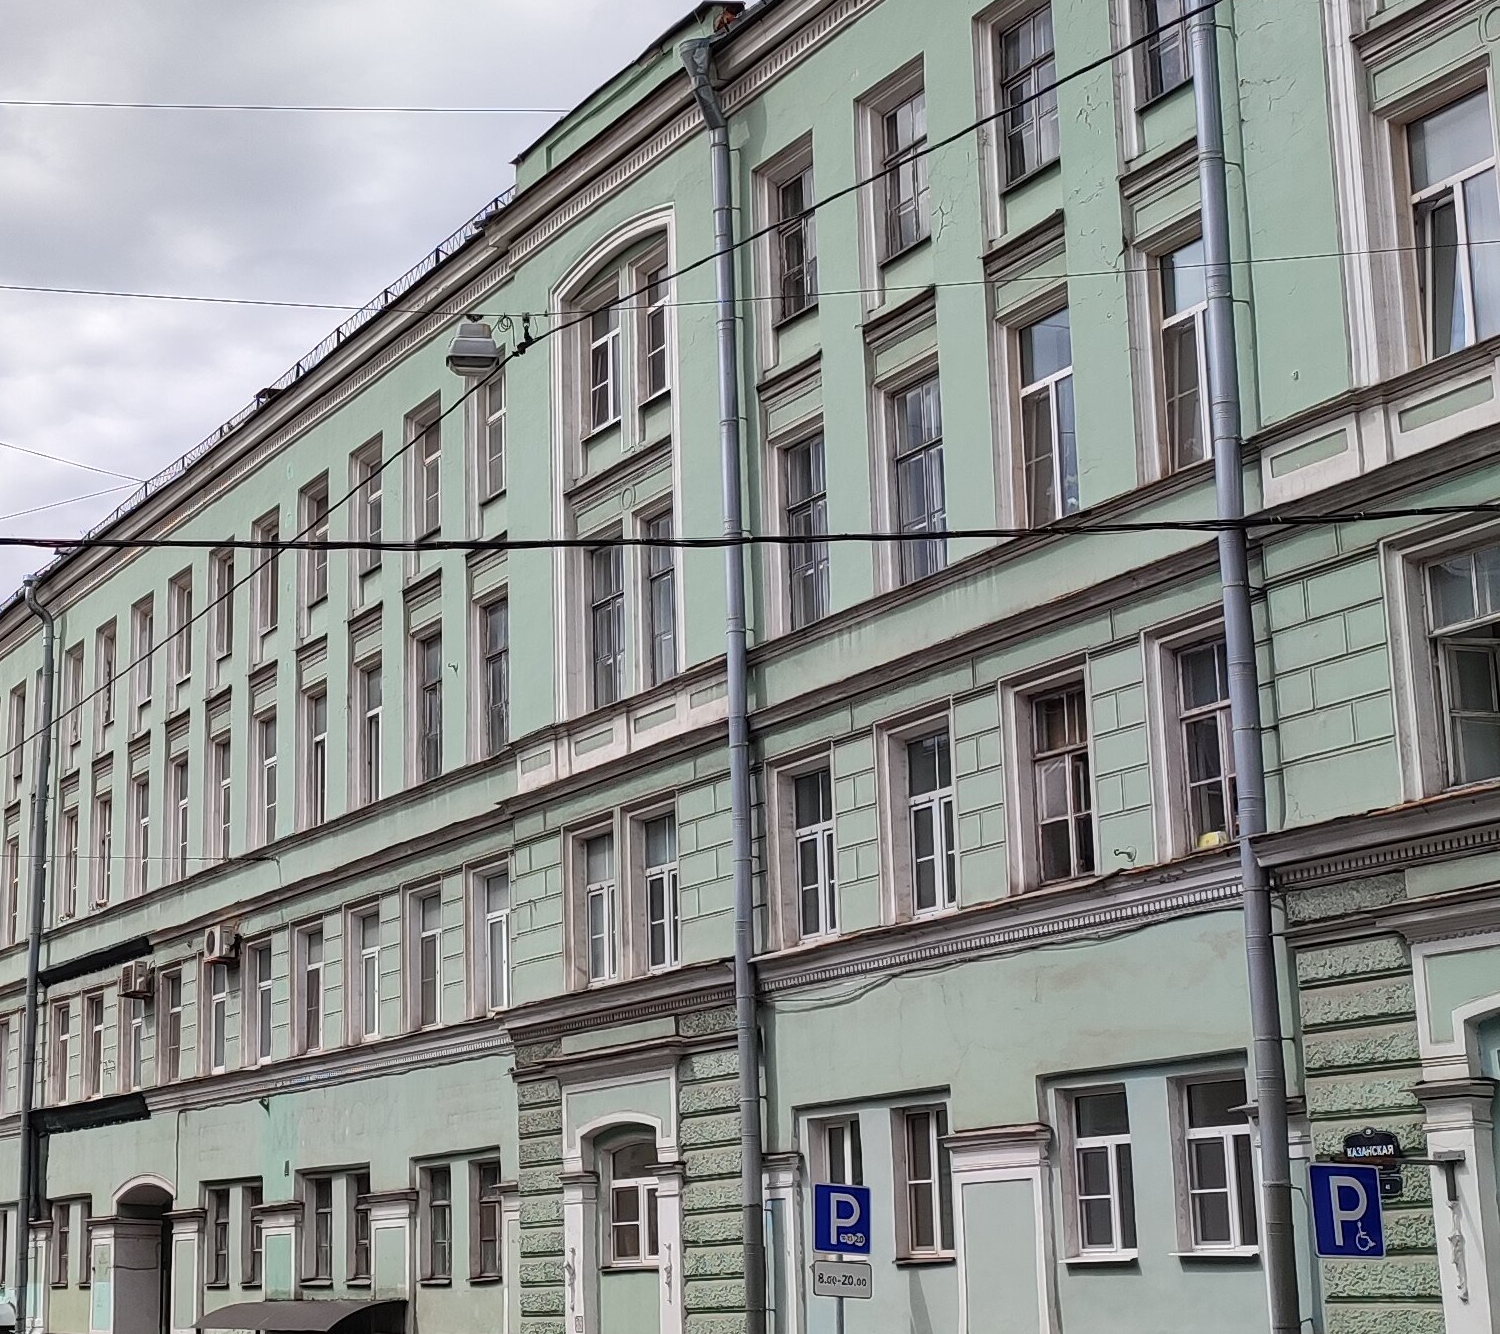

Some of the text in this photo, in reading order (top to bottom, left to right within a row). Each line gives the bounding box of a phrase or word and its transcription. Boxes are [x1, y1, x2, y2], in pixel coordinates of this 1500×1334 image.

[1347, 1144, 1394, 1157] КАЗАНСКАЯ
[830, 1192, 860, 1245] P
[1329, 1175, 1368, 1246] P
[818, 1273, 867, 1287] 8.00-20.00
